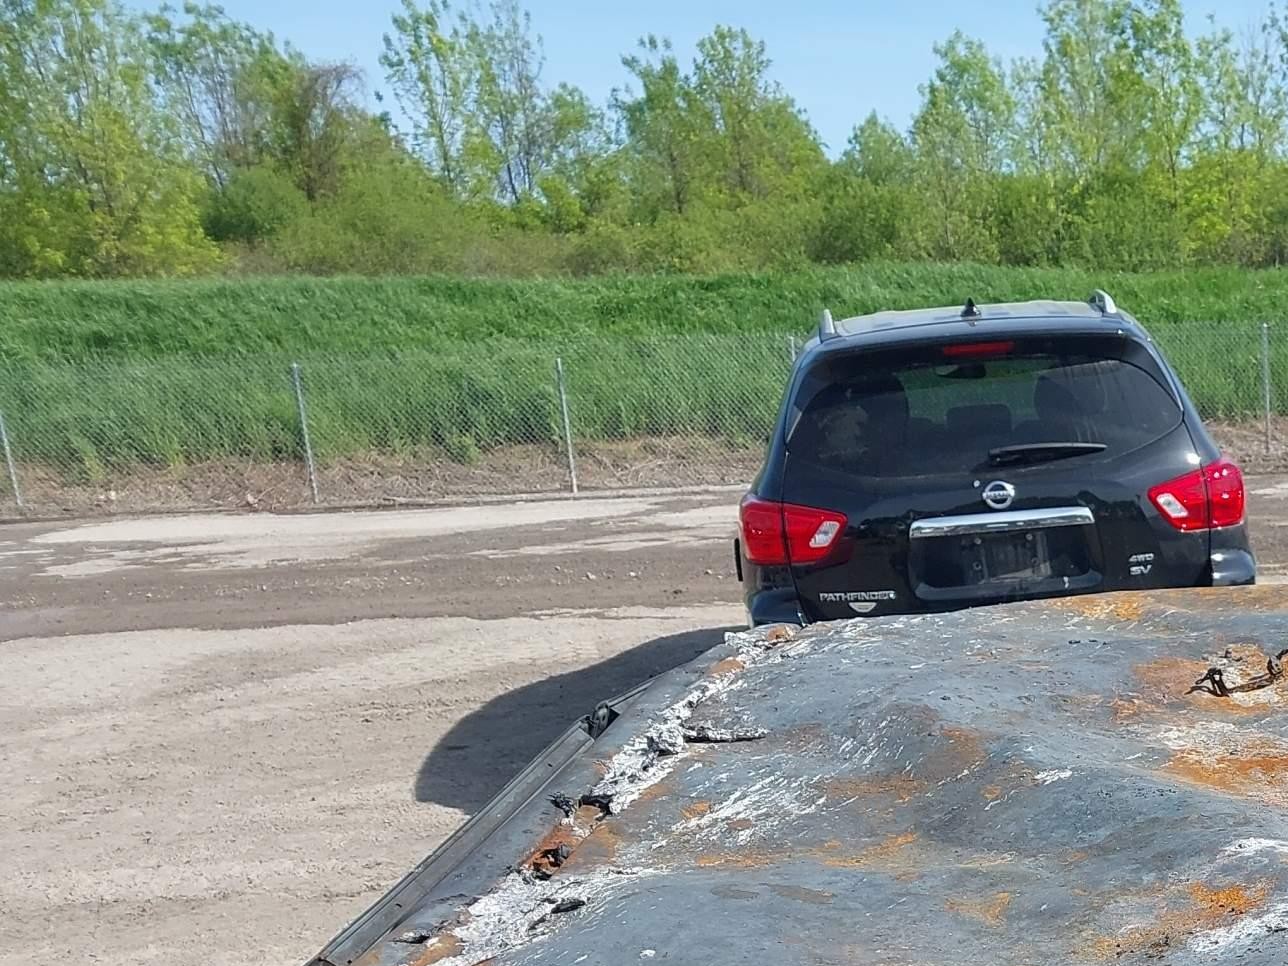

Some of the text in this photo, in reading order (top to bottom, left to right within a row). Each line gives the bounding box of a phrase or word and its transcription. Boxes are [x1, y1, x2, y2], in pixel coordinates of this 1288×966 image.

[1129, 553, 1154, 562] 4WD
[1130, 565, 1152, 575] SV
[819, 590, 896, 602] PATHFINDER
